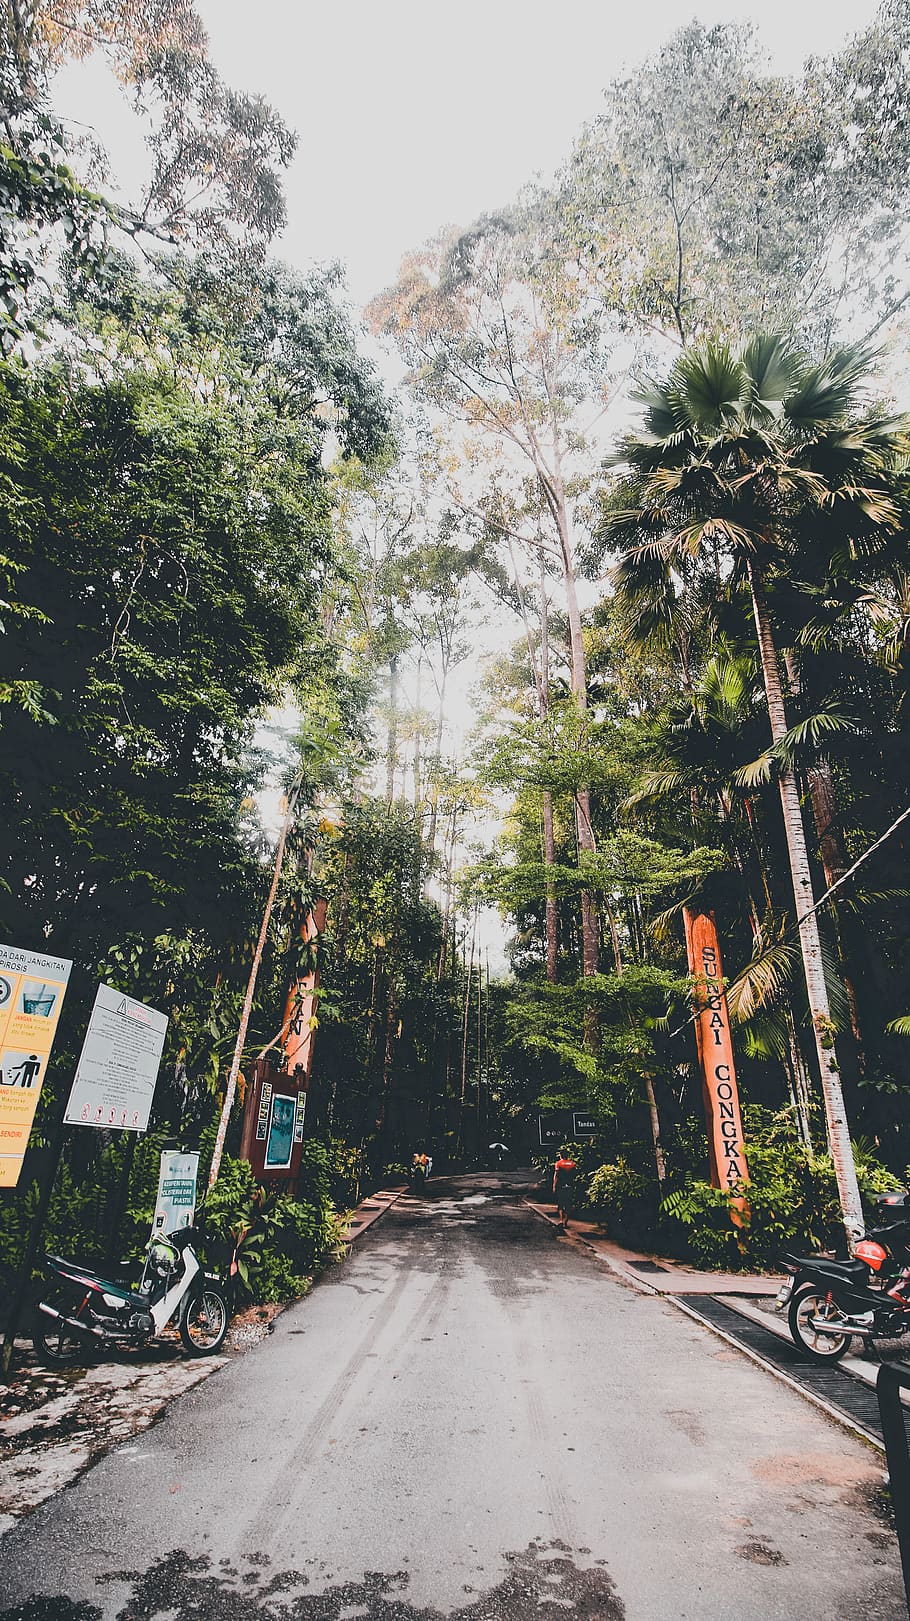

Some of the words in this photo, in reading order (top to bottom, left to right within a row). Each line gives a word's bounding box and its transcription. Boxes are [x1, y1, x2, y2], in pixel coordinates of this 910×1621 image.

[9, 952, 27, 962] DARI
[27, 957, 66, 971] JANGKITAN
[702, 946, 724, 1045] SUNGAI
[715, 1064, 745, 1198] CONGKAK
